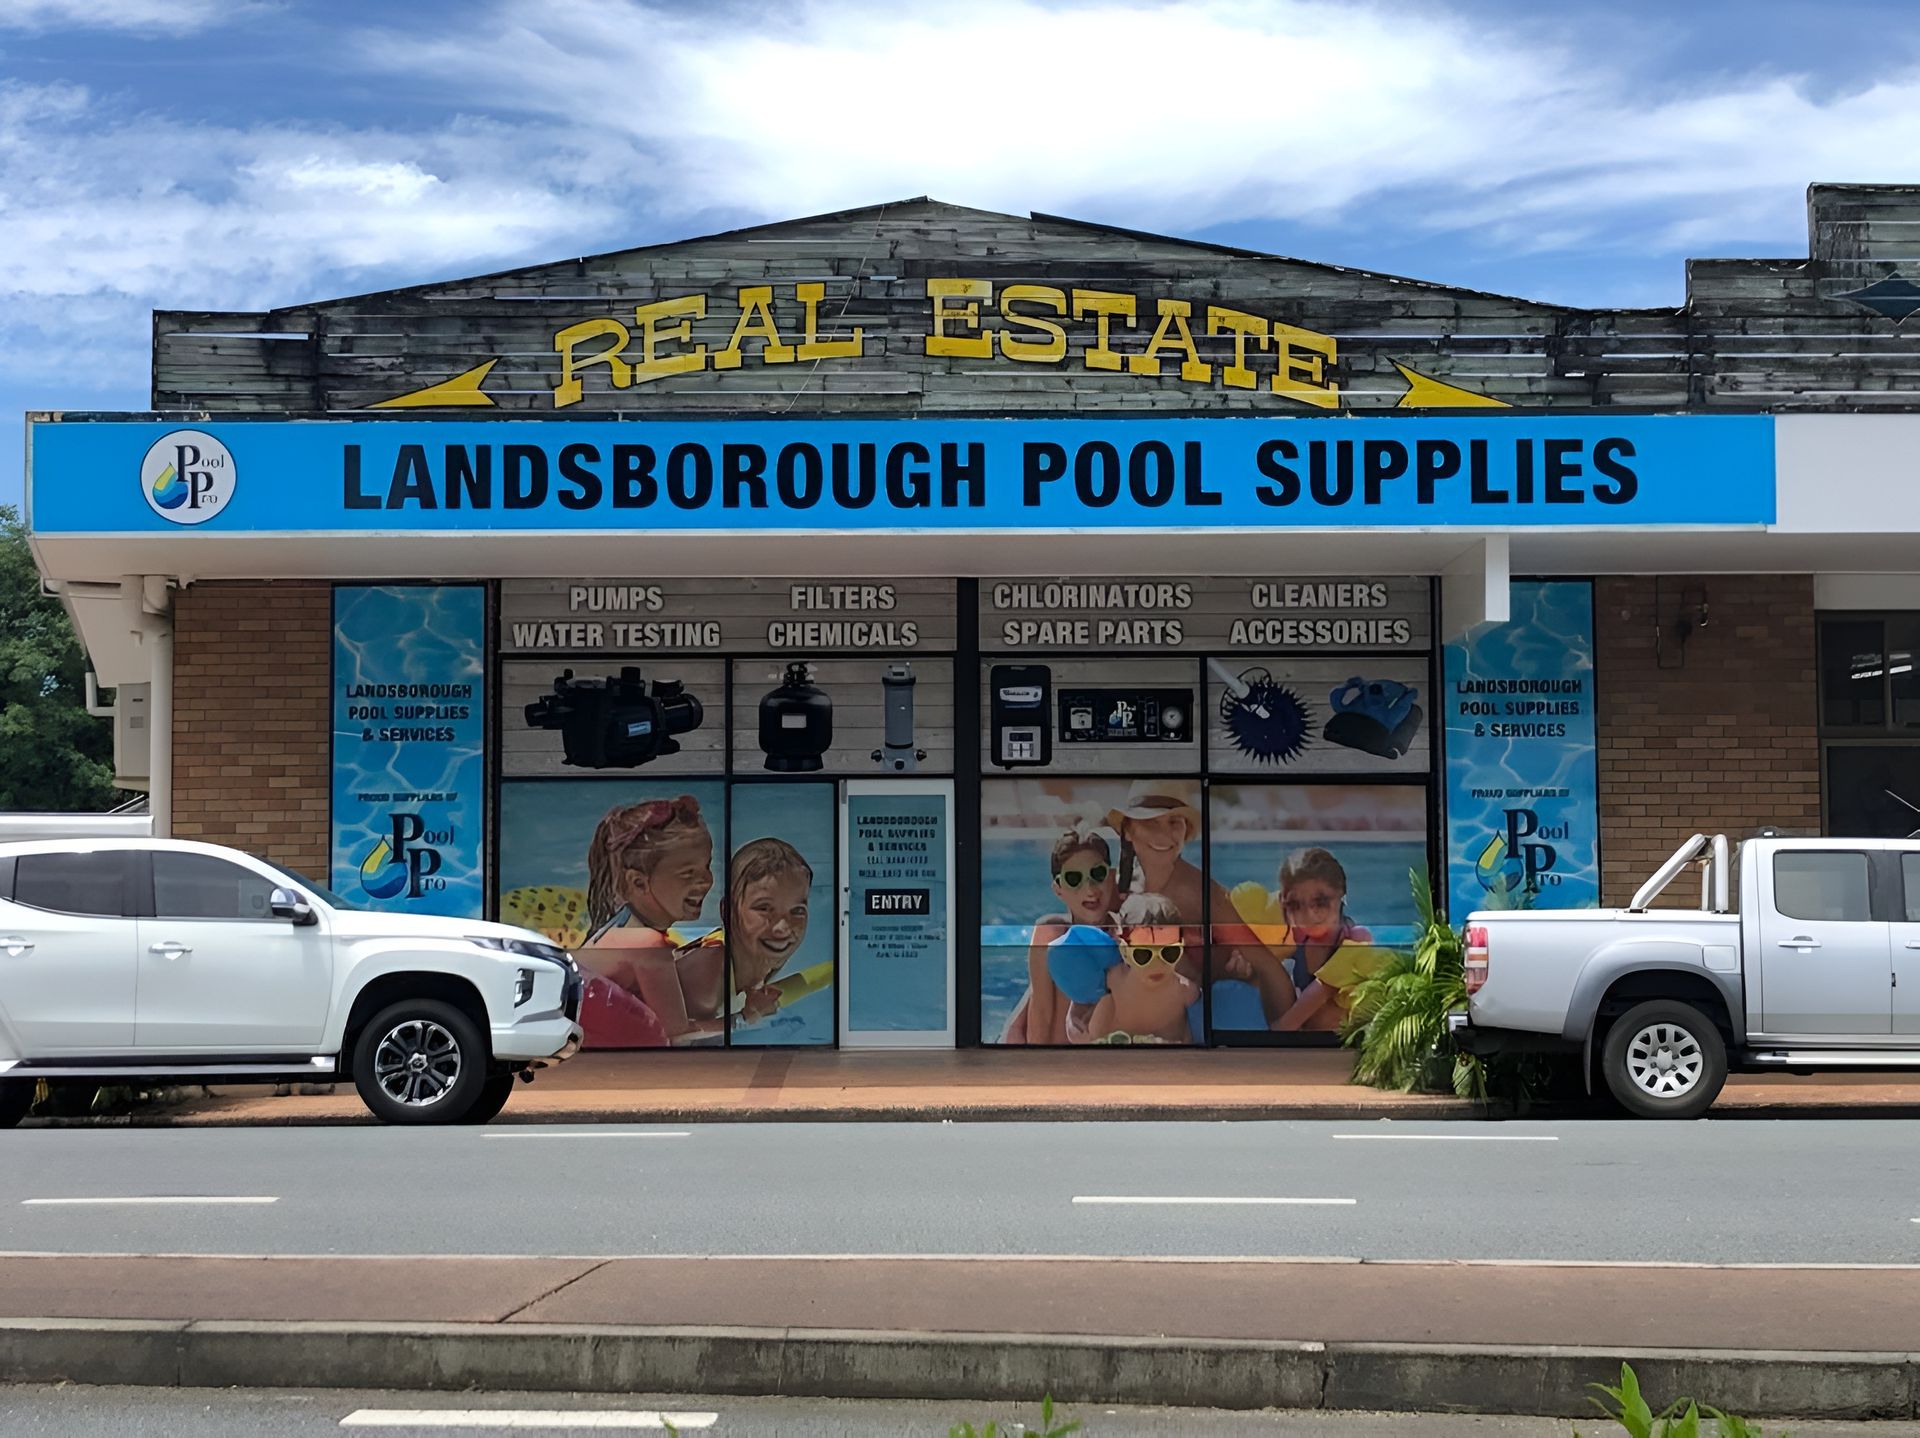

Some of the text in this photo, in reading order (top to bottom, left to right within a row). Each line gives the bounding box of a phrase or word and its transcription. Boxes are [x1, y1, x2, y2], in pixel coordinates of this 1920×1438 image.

[554, 278, 1339, 409] REAL ESTATE
[174, 445, 224, 482] Pool
[342, 437, 1639, 510] LANDSBOROUGH POOL SUPPLIES
[187, 471, 218, 509] Pro
[570, 586, 664, 610] PUMPS
[791, 585, 897, 610] FILTERS
[993, 583, 1192, 609] CHLORINATORS
[1251, 583, 1388, 608] CLEANERS
[513, 623, 721, 648] WATER TESTING
[768, 622, 918, 647] CHEMICALS
[1003, 620, 1182, 645] SPARE PARTS
[1230, 619, 1410, 645] ACCESSORIES
[346, 684, 472, 698] LANDSBOROUGH
[1457, 679, 1582, 694] LANDSBOROUGH
[349, 705, 469, 720] POOL SUPPLIES
[1460, 701, 1579, 715] POOL SUPPLIES
[362, 727, 455, 742] & SERVICES
[1474, 723, 1566, 737] & SERVICES
[388, 813, 454, 864] Pool
[1502, 809, 1569, 858] Pool
[405, 848, 447, 898] Pro
[1523, 843, 1562, 893] Pro
[871, 895, 923, 910] ENTRY
